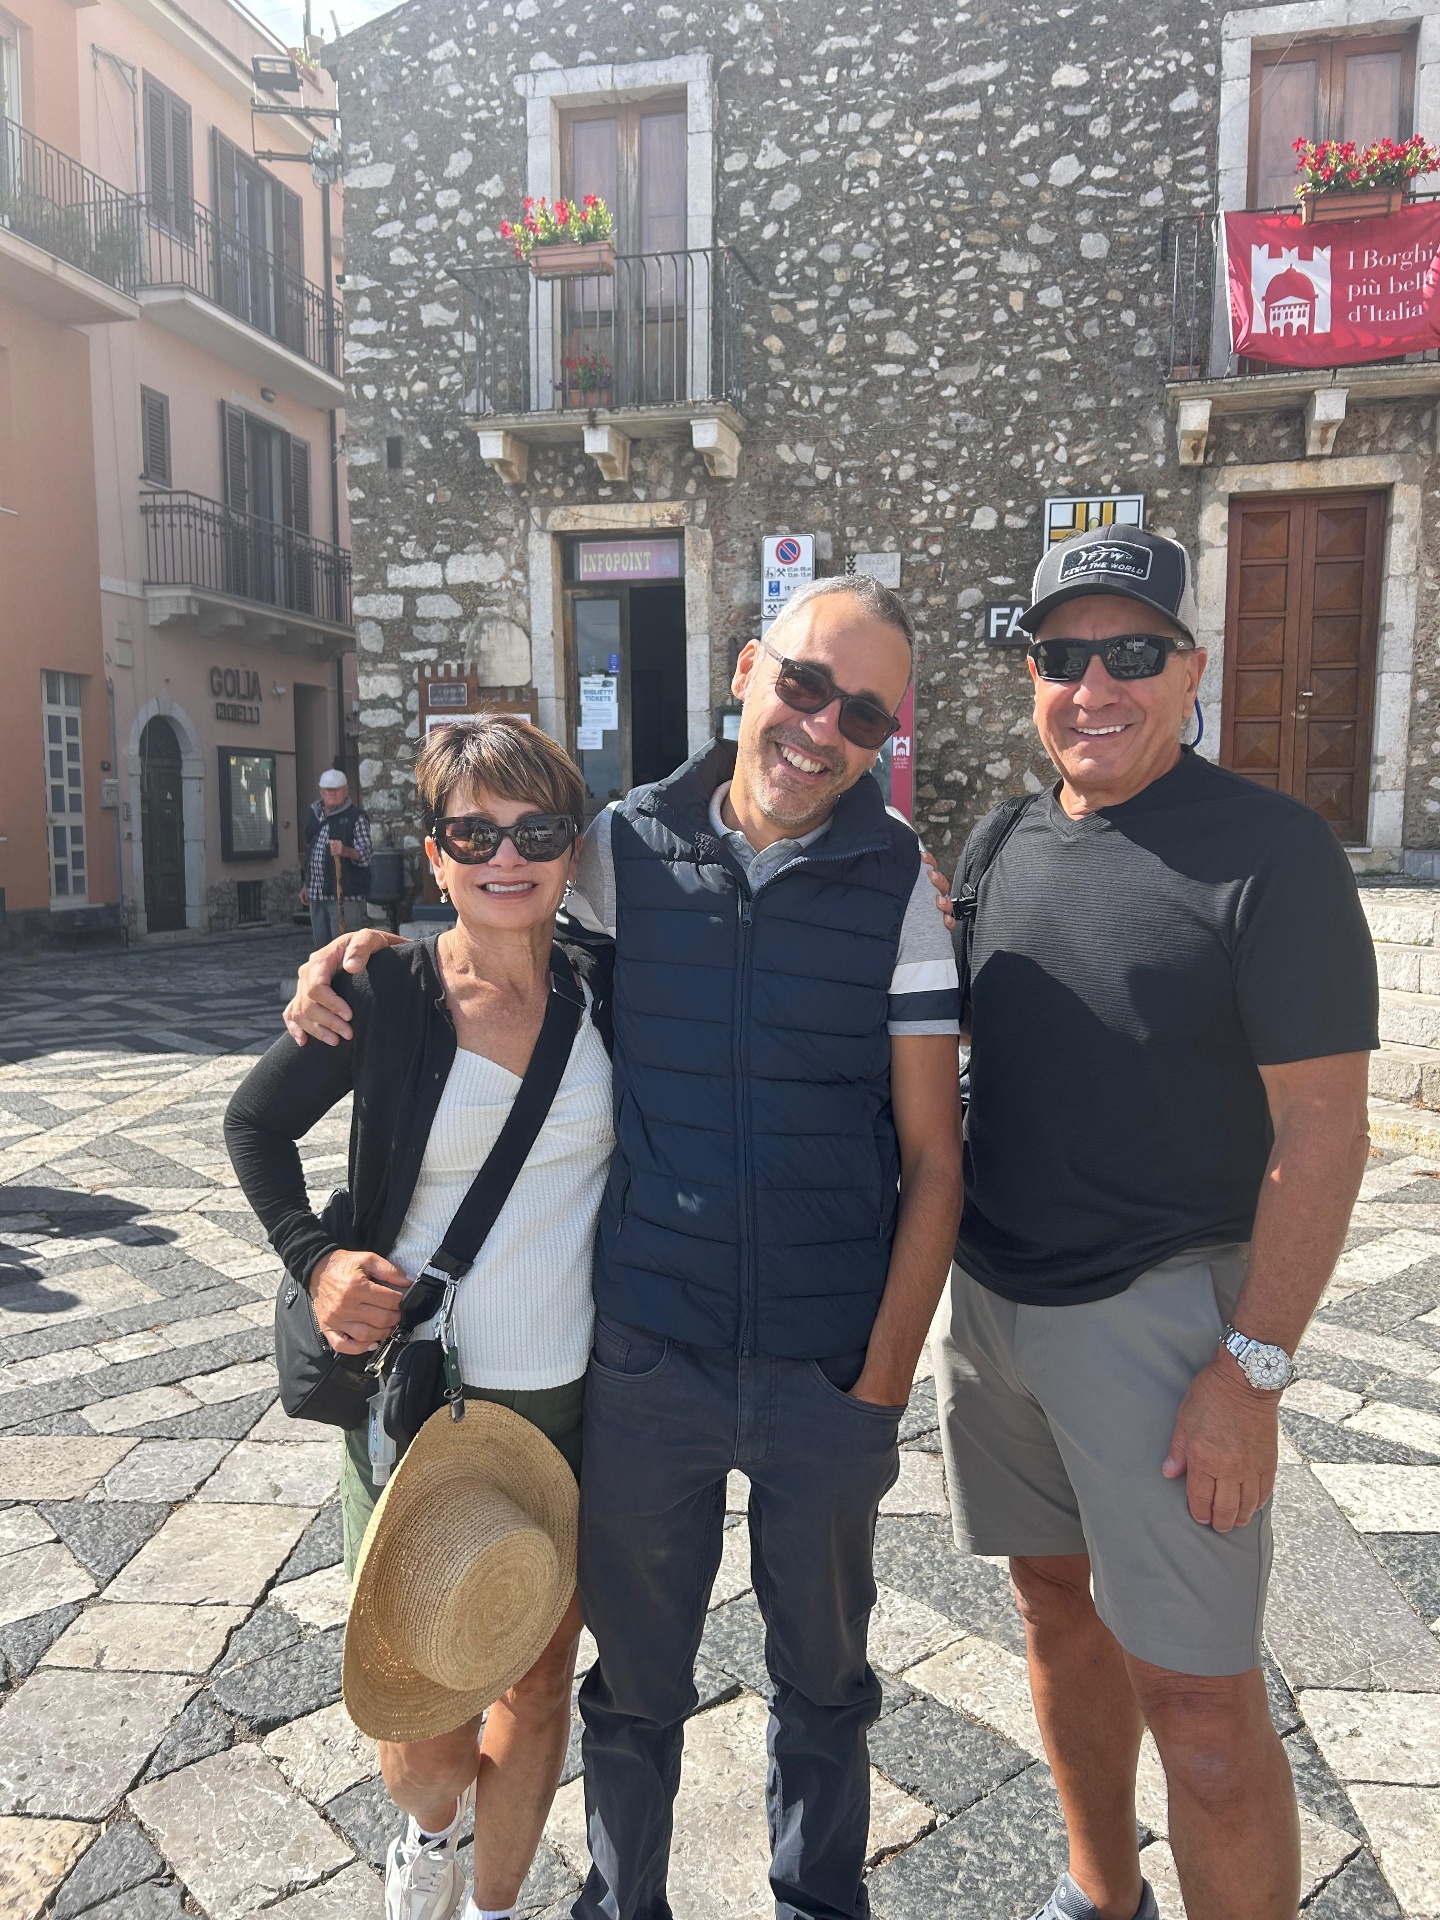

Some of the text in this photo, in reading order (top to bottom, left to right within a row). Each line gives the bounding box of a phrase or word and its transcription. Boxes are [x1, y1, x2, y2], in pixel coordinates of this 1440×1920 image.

[1348, 241, 1433, 271] I Borghi
[1348, 278, 1381, 302] più
[1348, 300, 1424, 322] d'Italia
[583, 551, 652, 573] INFOPOINT
[1089, 561, 1108, 570] THE
[1110, 562, 1144, 575] WORLD
[209, 665, 262, 702] GOLIA
